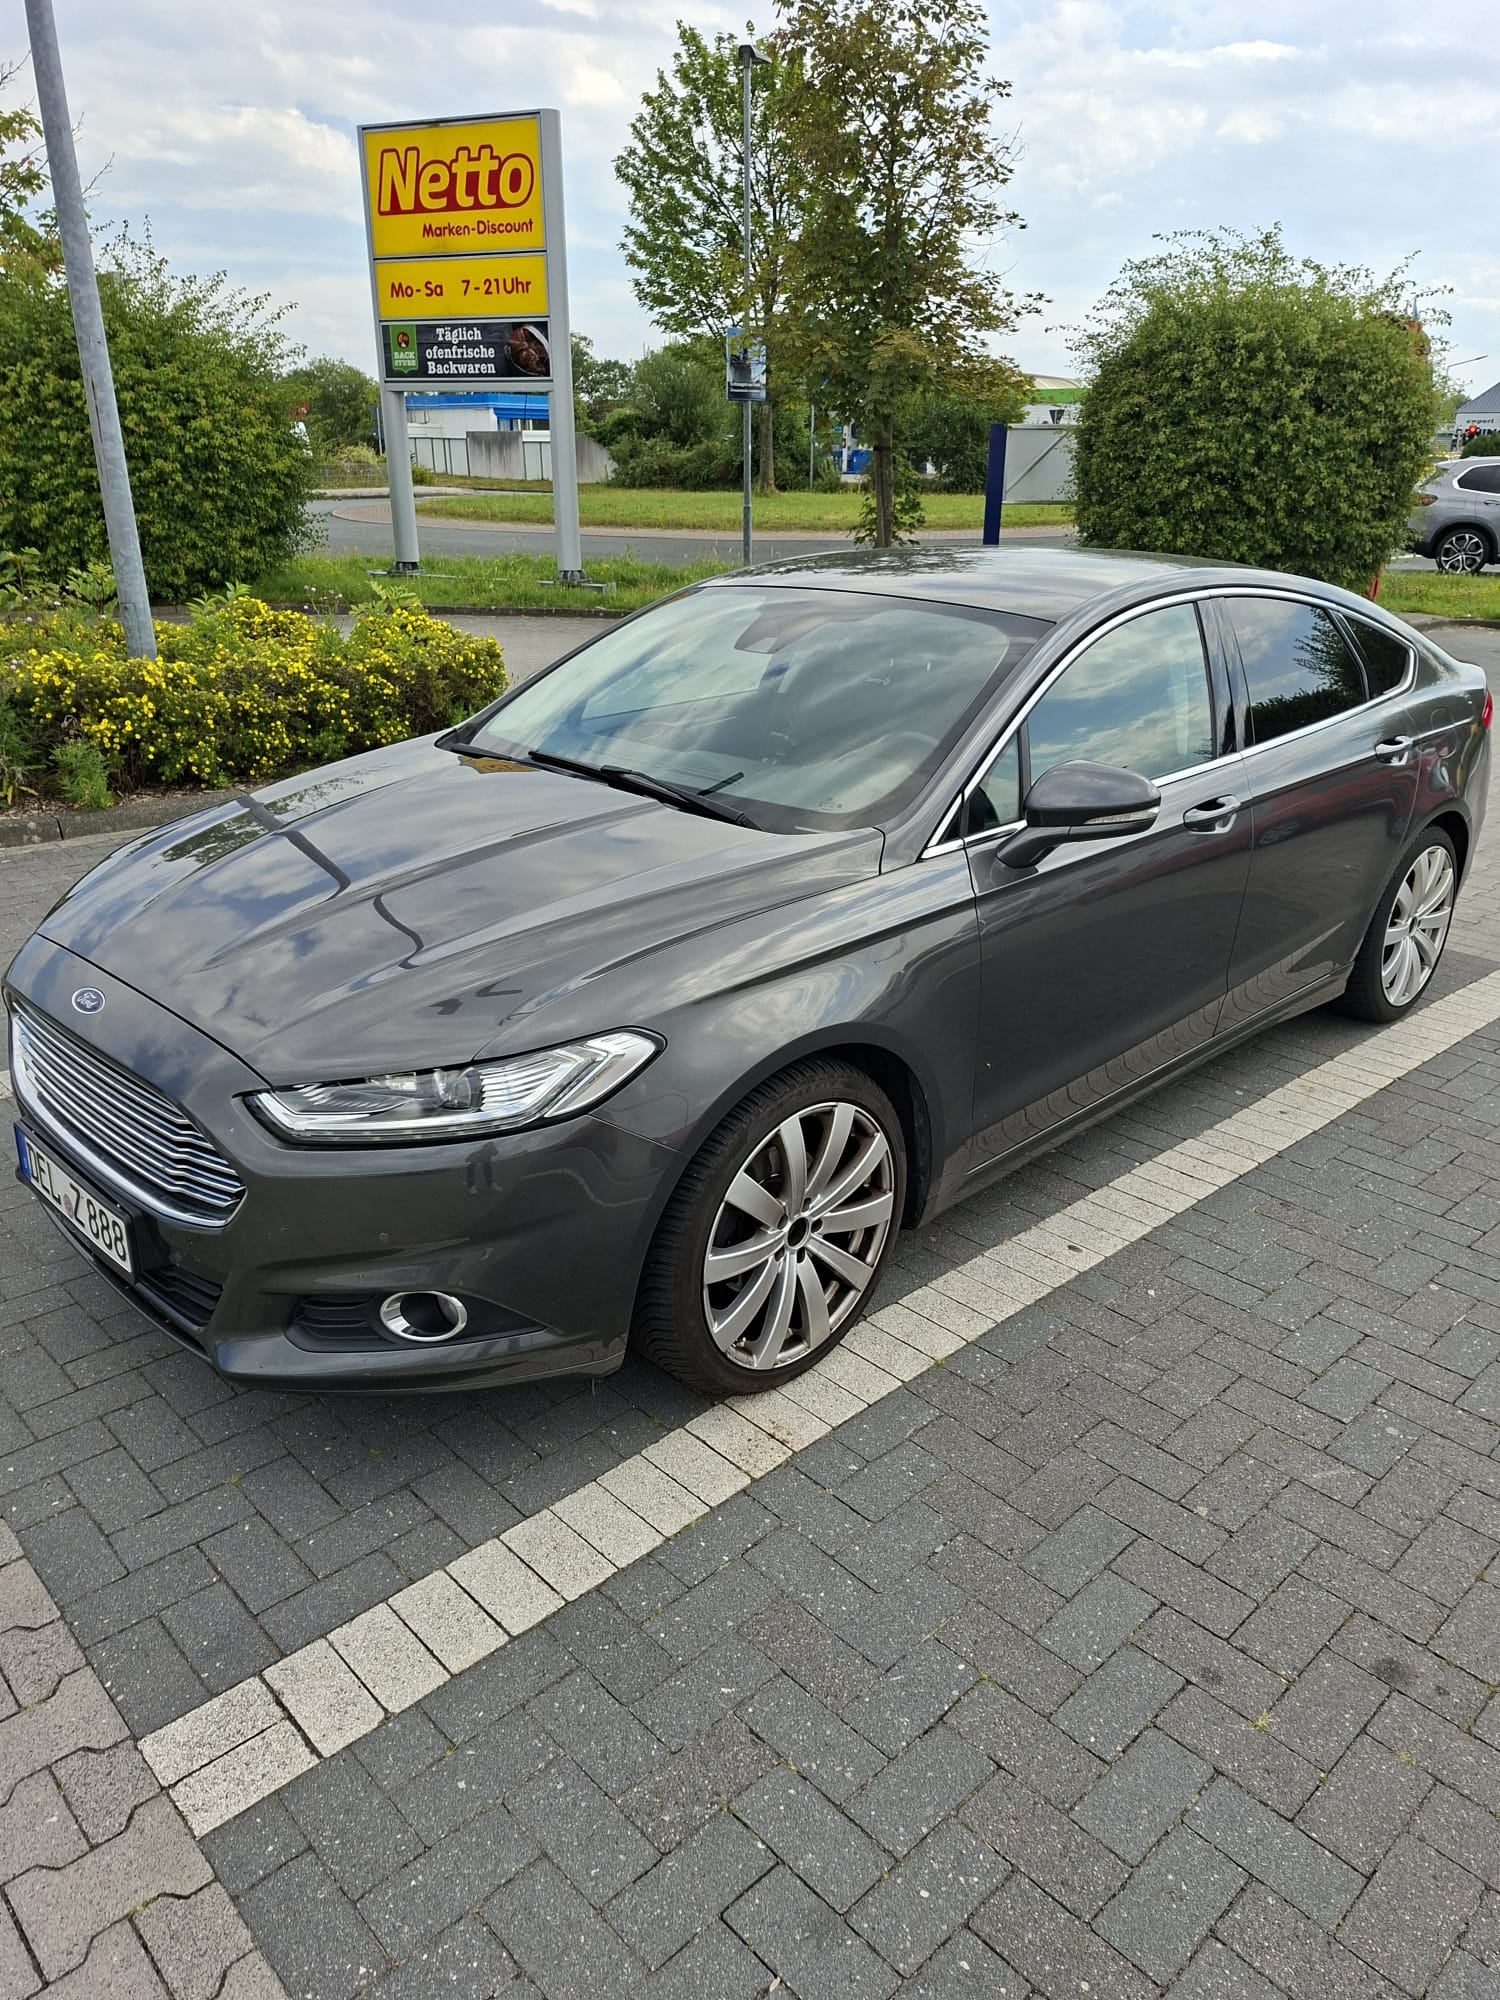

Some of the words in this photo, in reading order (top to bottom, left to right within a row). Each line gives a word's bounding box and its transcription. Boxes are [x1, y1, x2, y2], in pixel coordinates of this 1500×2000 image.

[378, 144, 535, 216] Netto
[422, 218, 534, 238] Marken-Discount
[435, 327, 482, 344] Täglich
[393, 351, 416, 360] BACK
[425, 346, 495, 359] ofenfrische
[427, 361, 496, 375] Backwaren
[26, 1142, 62, 1205] DEL
